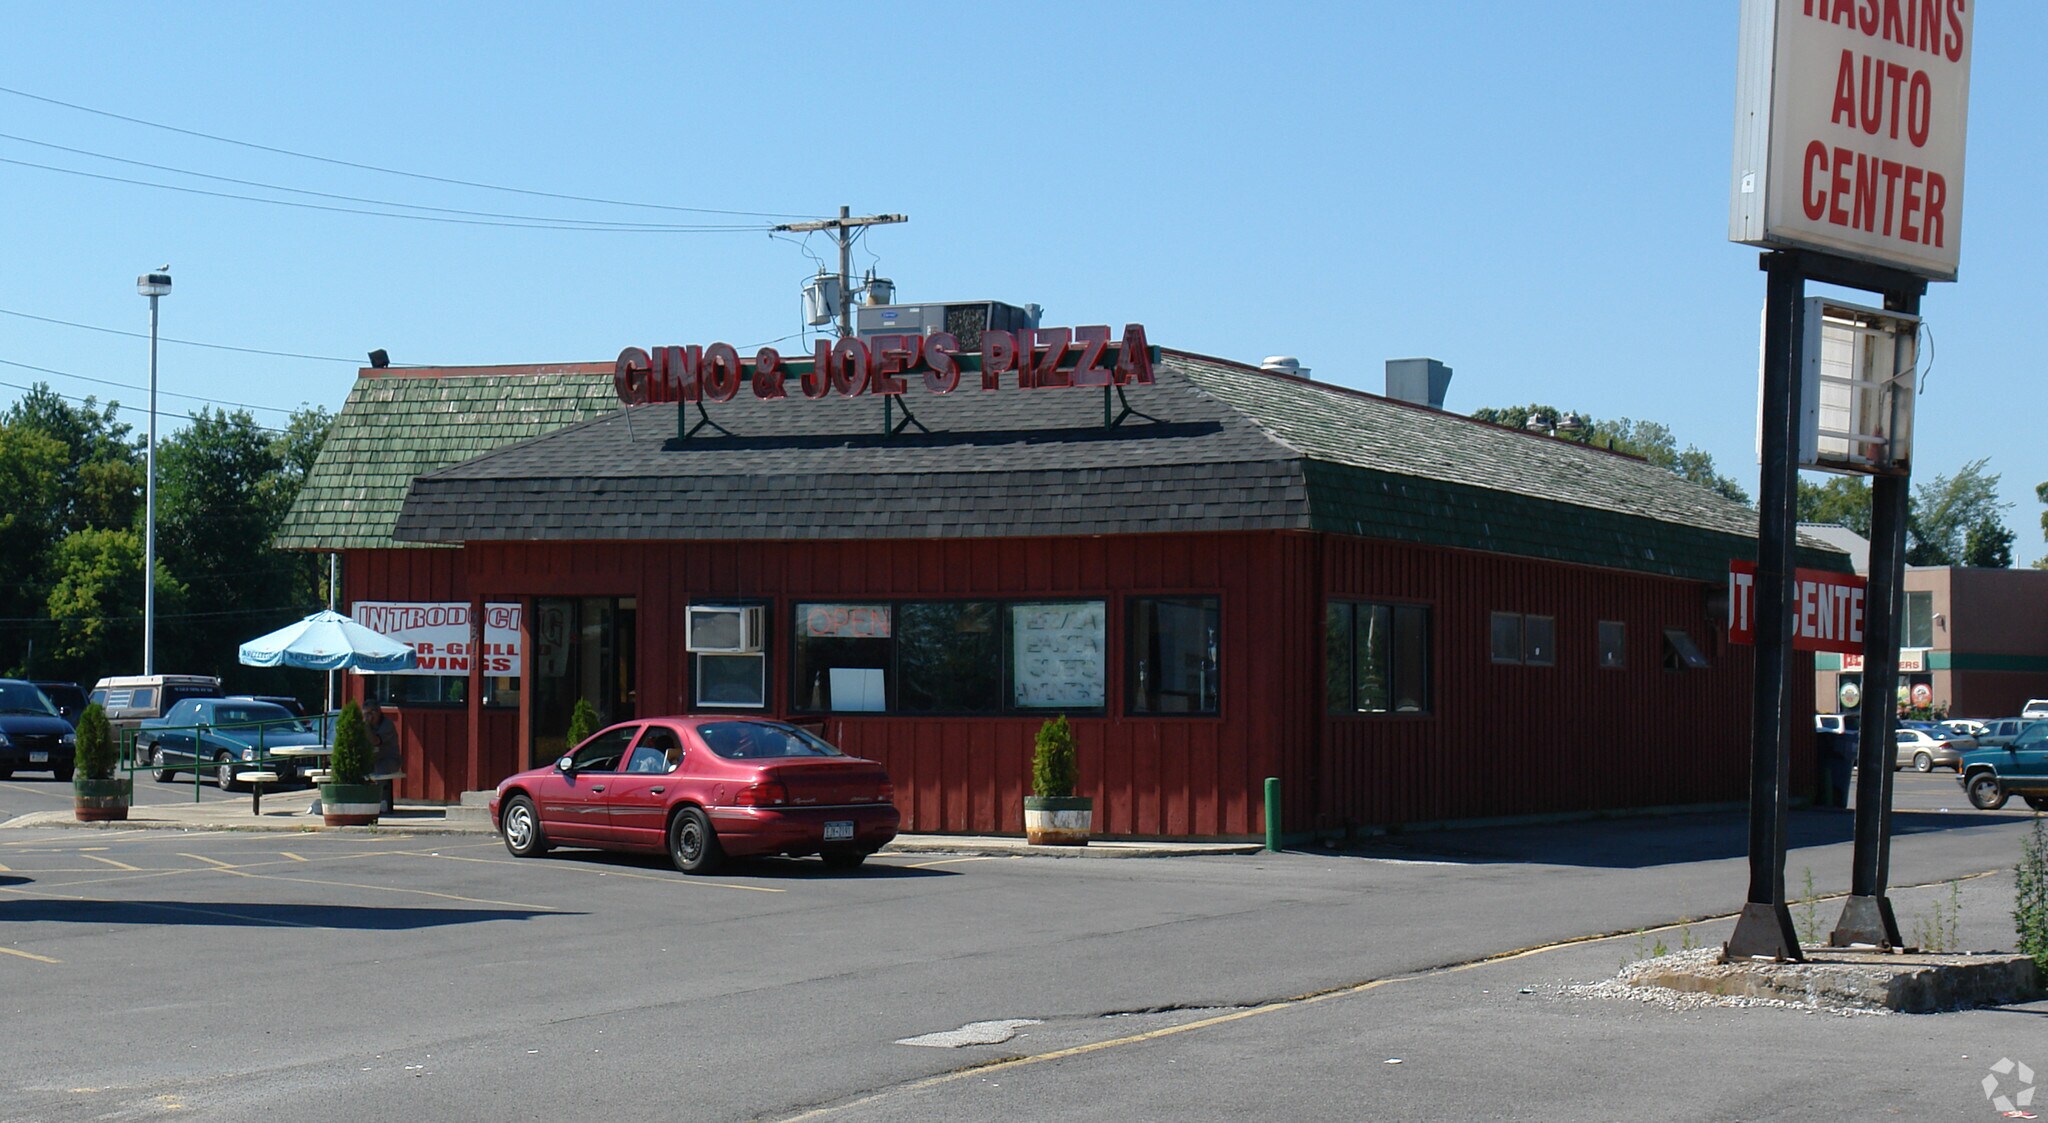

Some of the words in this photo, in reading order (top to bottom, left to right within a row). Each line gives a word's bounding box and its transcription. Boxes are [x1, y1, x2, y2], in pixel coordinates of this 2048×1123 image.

[1803, 0, 1965, 63] KINS
[1831, 49, 1932, 148] AUTO
[1802, 139, 1946, 248] CENTER
[614, 342, 742, 406] GINO
[752, 347, 788, 399] &
[801, 331, 961, 398] JOE'S
[981, 323, 1155, 390] PIZZA
[807, 607, 890, 636] OPEN
